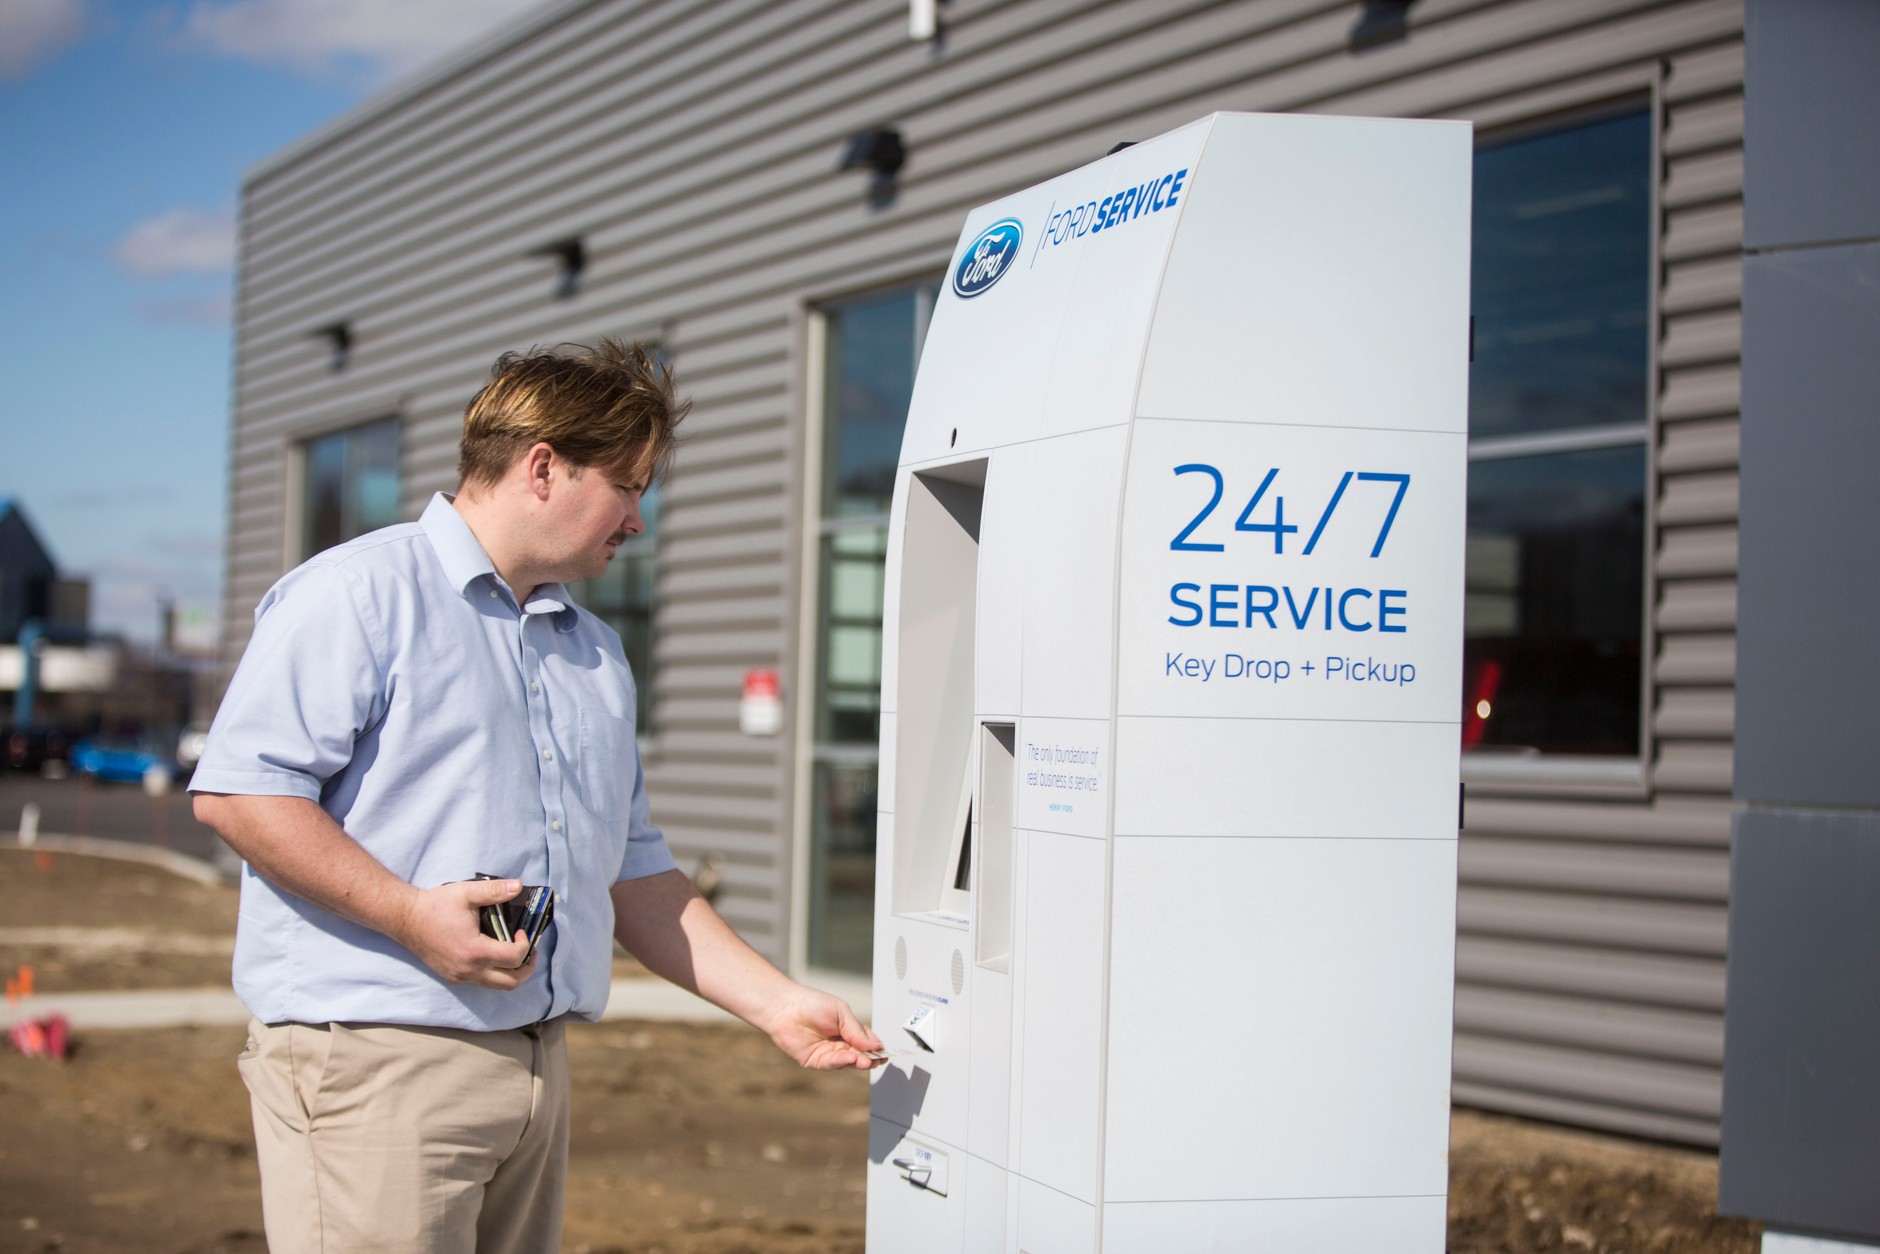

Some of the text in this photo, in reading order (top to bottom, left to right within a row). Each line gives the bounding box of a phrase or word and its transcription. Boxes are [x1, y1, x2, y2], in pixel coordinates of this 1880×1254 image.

[960, 230, 1012, 287] Ford
[1169, 463, 1411, 558] 24/7
[1167, 582, 1408, 633] SERVICE
[1165, 652, 1216, 682] Key
[1224, 653, 1291, 684] Drop
[1325, 656, 1416, 687] Pickup
[1040, 744, 1054, 765] only
[1055, 744, 1089, 766] foundation
[1090, 746, 1099, 768] of
[1027, 769, 1039, 786] real
[1040, 768, 1067, 789] business
